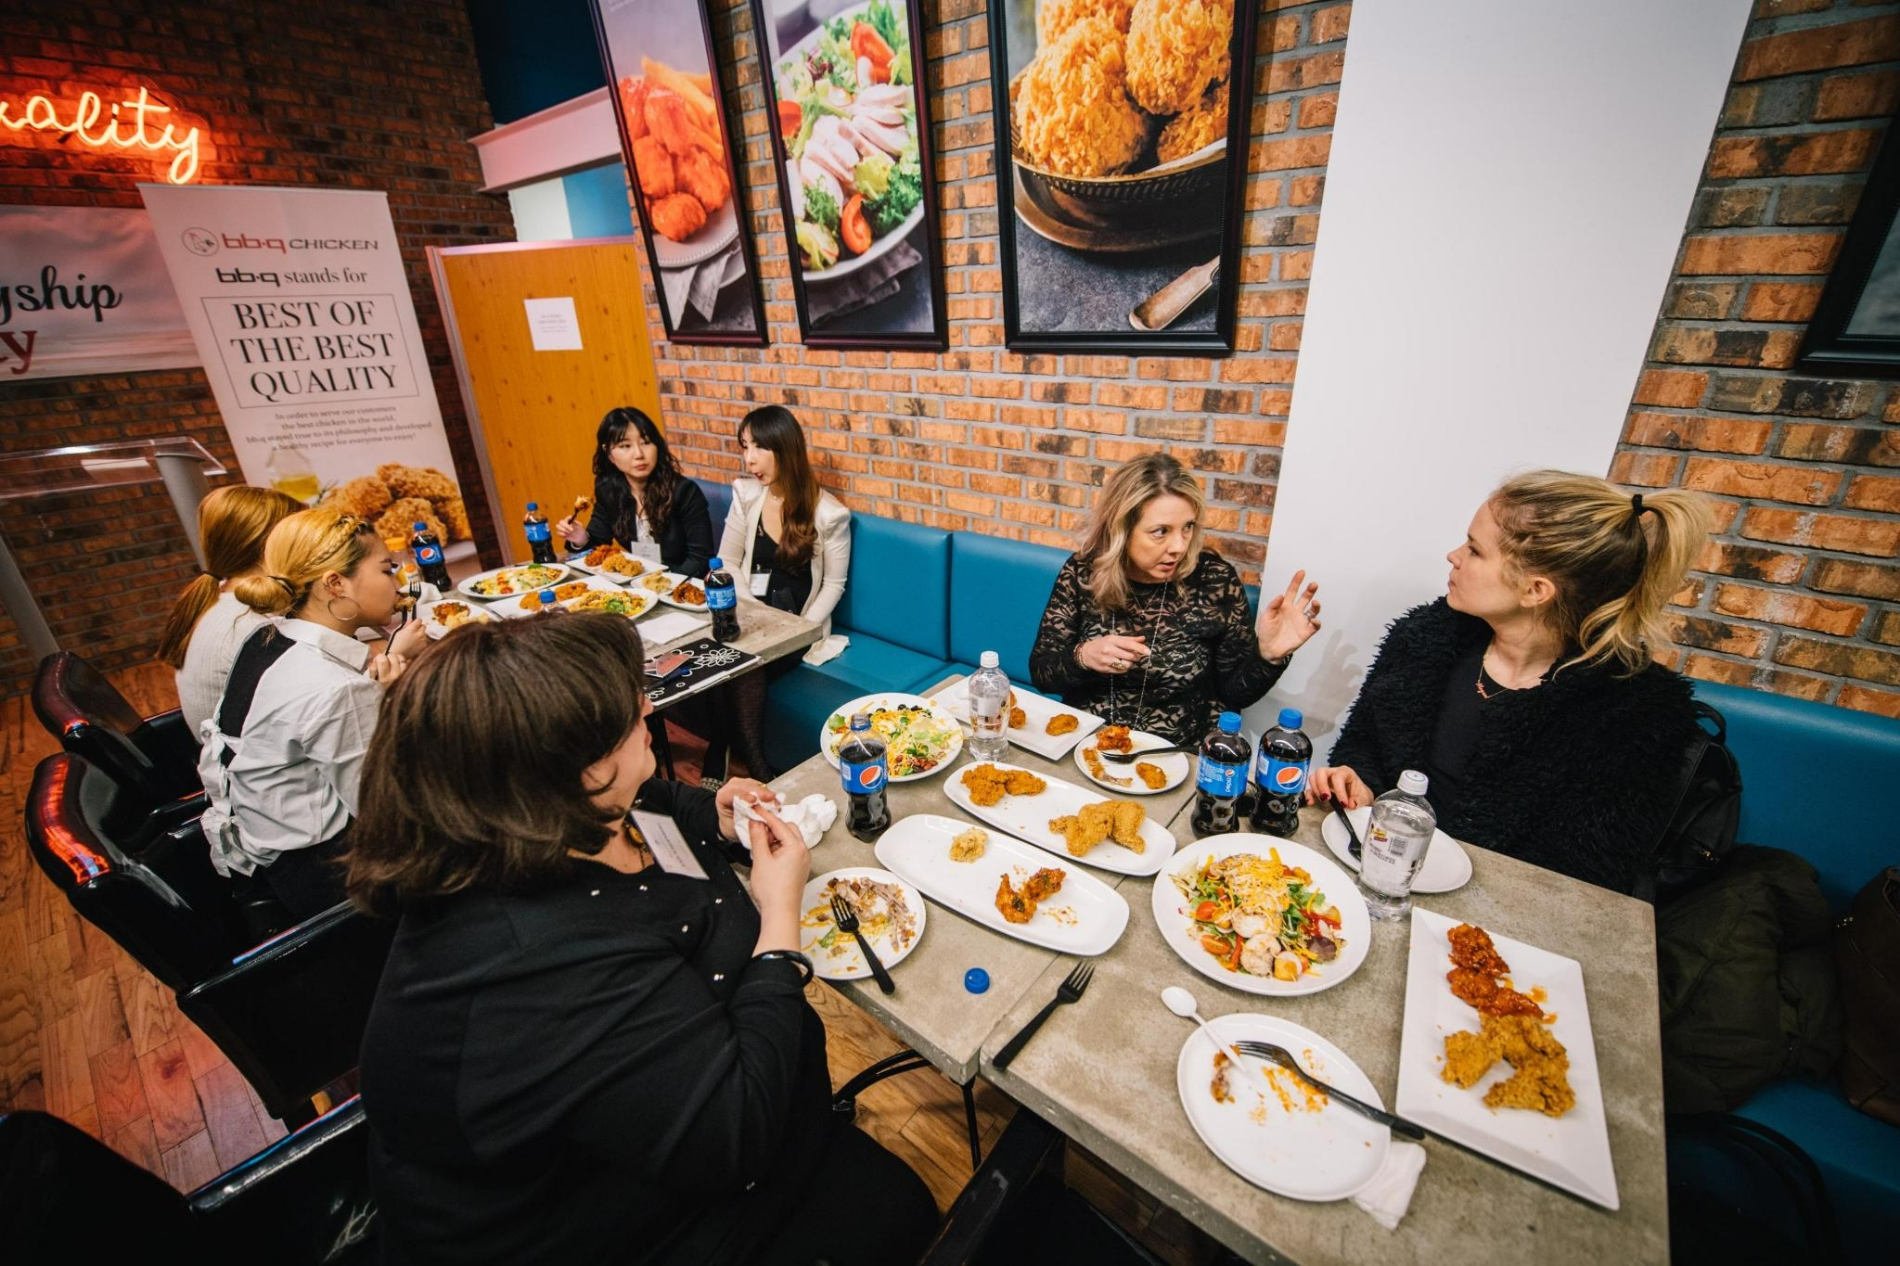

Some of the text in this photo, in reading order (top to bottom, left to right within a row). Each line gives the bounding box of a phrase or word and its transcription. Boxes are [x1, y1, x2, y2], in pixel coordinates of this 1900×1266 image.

[288, 238, 379, 250] CHICKEN
[284, 267, 341, 284] stands
[343, 267, 367, 283] for
[231, 300, 375, 330] BEST OF
[230, 332, 394, 364] THE BEST
[250, 364, 397, 403] QUALITY
[286, 412, 308, 420] order
[320, 410, 340, 418] serve
[357, 406, 396, 415] customers
[267, 433, 293, 443] stayed
[294, 431, 312, 439] true
[323, 429, 334, 437] its
[335, 425, 378, 437] philosophy
[379, 424, 393, 432] and
[394, 421, 432, 430] developed
[296, 421, 314, 429] best
[315, 419, 347, 428] chicken
[310, 439, 335, 448] recipe
[336, 437, 347, 445] for
[348, 436, 383, 446] everyone
